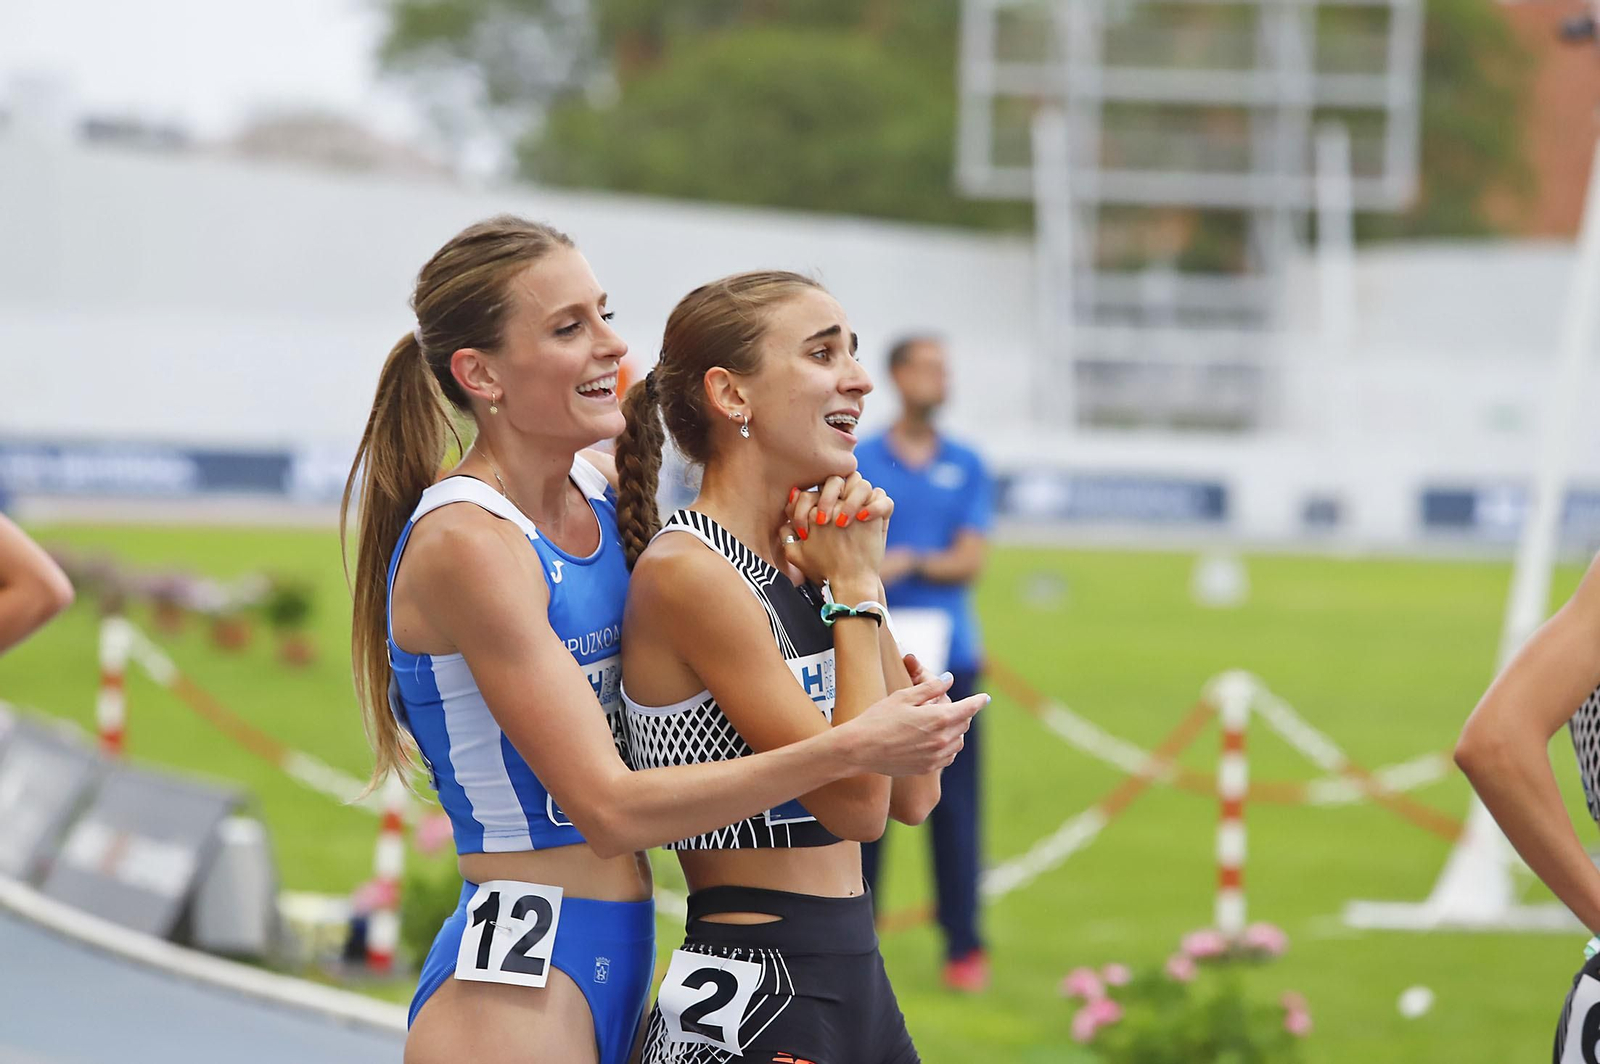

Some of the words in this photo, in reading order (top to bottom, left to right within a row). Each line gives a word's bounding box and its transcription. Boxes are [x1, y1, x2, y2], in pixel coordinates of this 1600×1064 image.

[802, 663, 824, 695] H
[472, 891, 553, 976] 12
[680, 967, 739, 1044] 2
